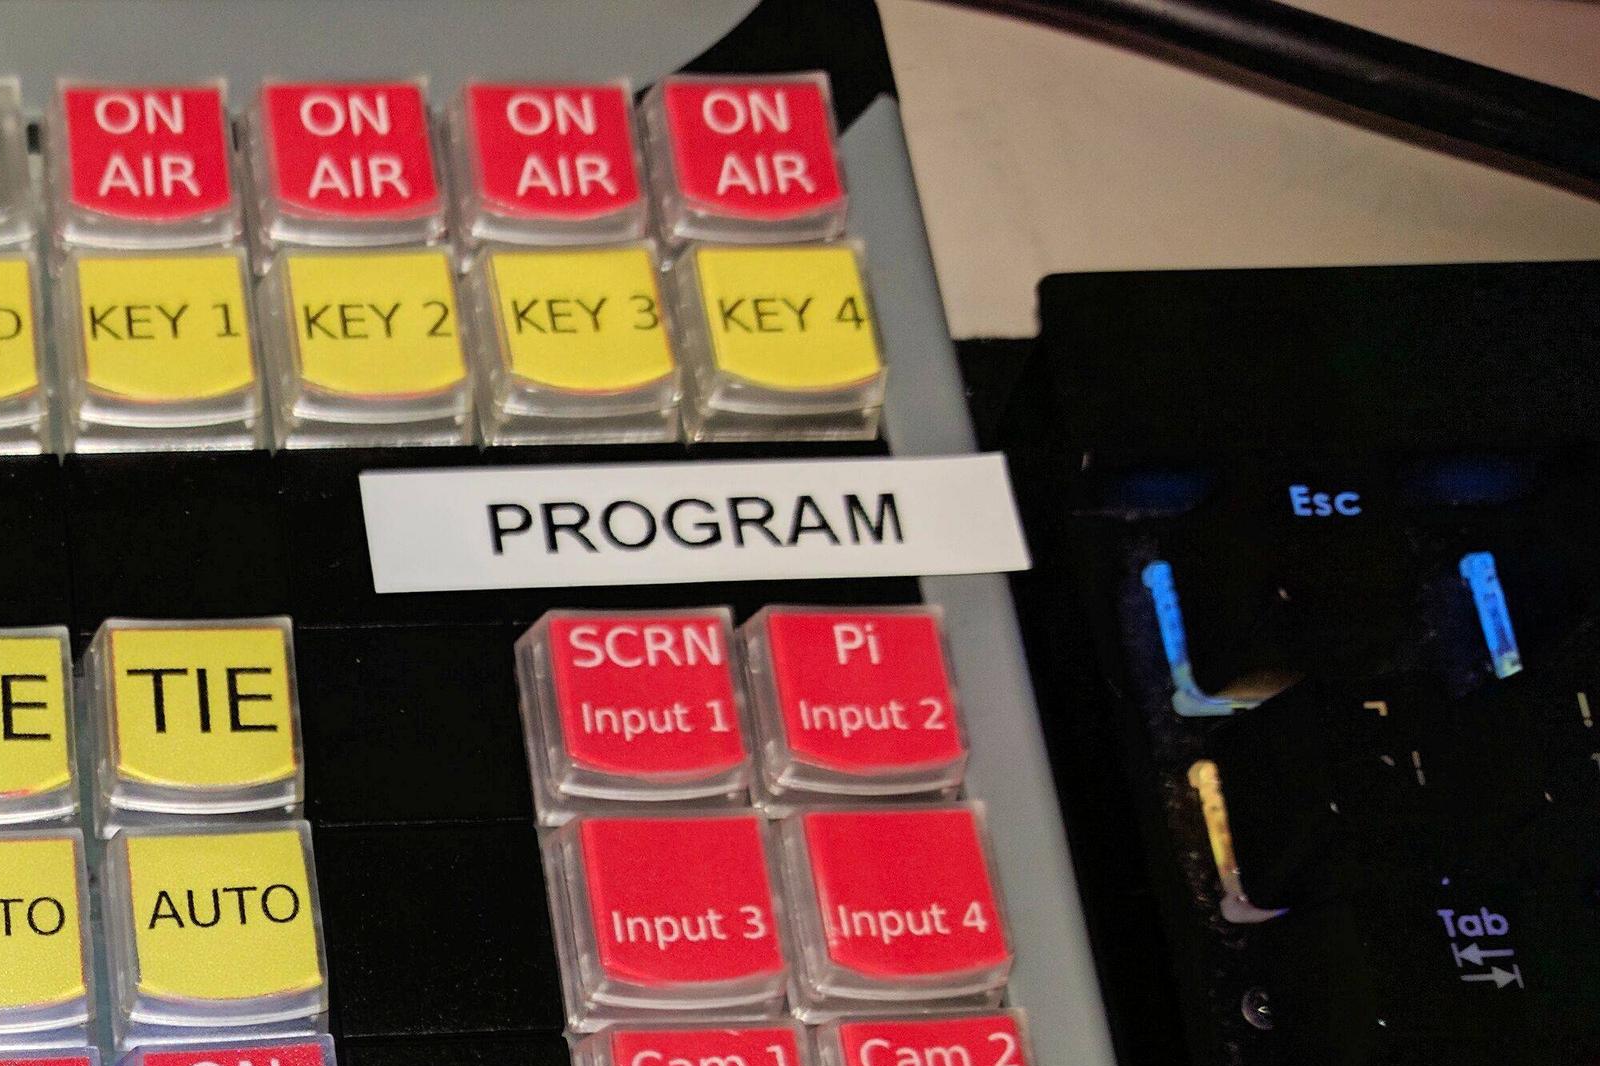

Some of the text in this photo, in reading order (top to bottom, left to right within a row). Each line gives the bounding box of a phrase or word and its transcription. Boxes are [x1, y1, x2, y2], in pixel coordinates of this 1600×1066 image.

[94, 94, 185, 136] ON
[299, 92, 390, 137] ON
[505, 92, 596, 137] ON
[701, 90, 791, 134] ON
[99, 151, 201, 199] AIR
[308, 154, 411, 200] AIR
[516, 152, 620, 199] AIR
[716, 151, 817, 196] AIR
[88, 301, 240, 342] KEY 1
[304, 300, 454, 341] KEY 2
[511, 292, 660, 335] KEY 3
[718, 295, 866, 334] KEY 4
[1289, 483, 1363, 517] Esc
[486, 492, 905, 556] PROGRAM
[567, 624, 724, 669] SCRN
[832, 624, 882, 666] Pi
[127, 667, 278, 734] TIE
[581, 701, 730, 741] Input 1
[799, 699, 946, 738] Input 2
[148, 883, 300, 930] AUTO
[611, 906, 767, 950] Input 3
[837, 900, 988, 943] Input 4
[1437, 907, 1509, 939] Tab
